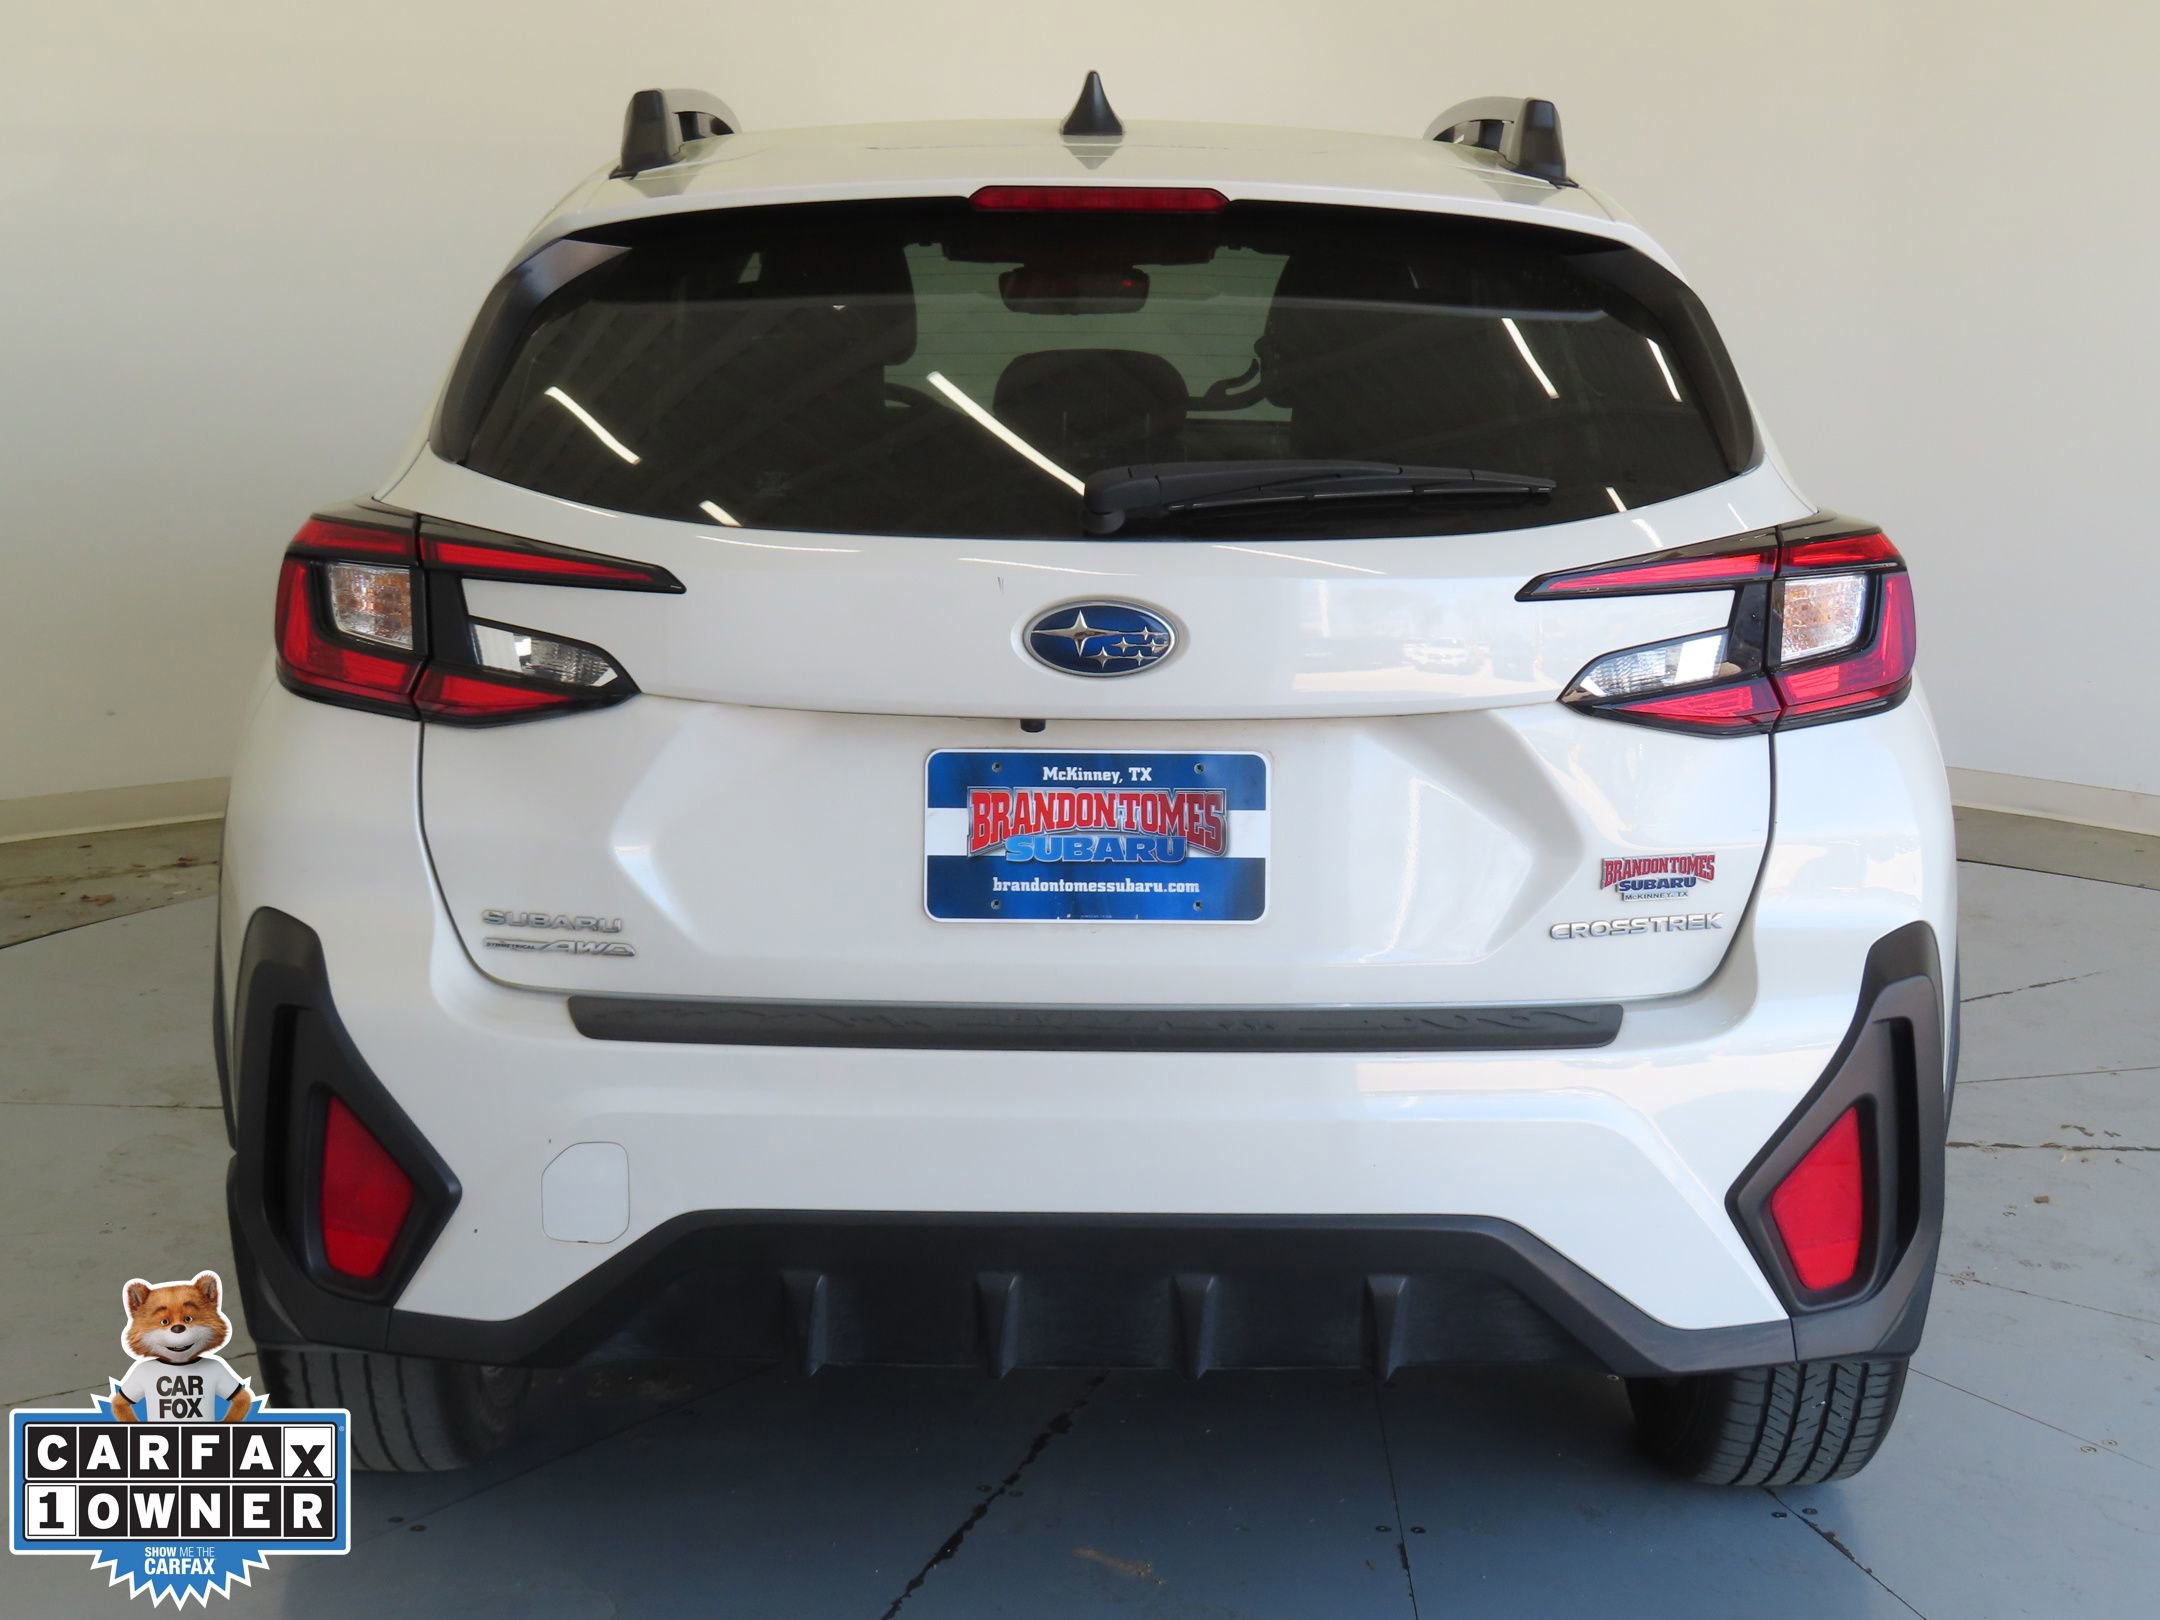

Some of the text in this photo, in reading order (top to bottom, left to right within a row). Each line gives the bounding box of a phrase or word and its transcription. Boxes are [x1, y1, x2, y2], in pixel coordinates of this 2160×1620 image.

[1043, 767, 1152, 784] McKinney, TX
[1005, 836, 1186, 863] SUBARU
[993, 877, 1200, 893] brandontomessubaru.com
[1619, 876, 1697, 892] SUBARU
[1677, 890, 1689, 898] TX
[483, 909, 622, 933] SUBARU
[1550, 912, 1724, 940] CROSSTREK
[540, 939, 636, 957] AWD
